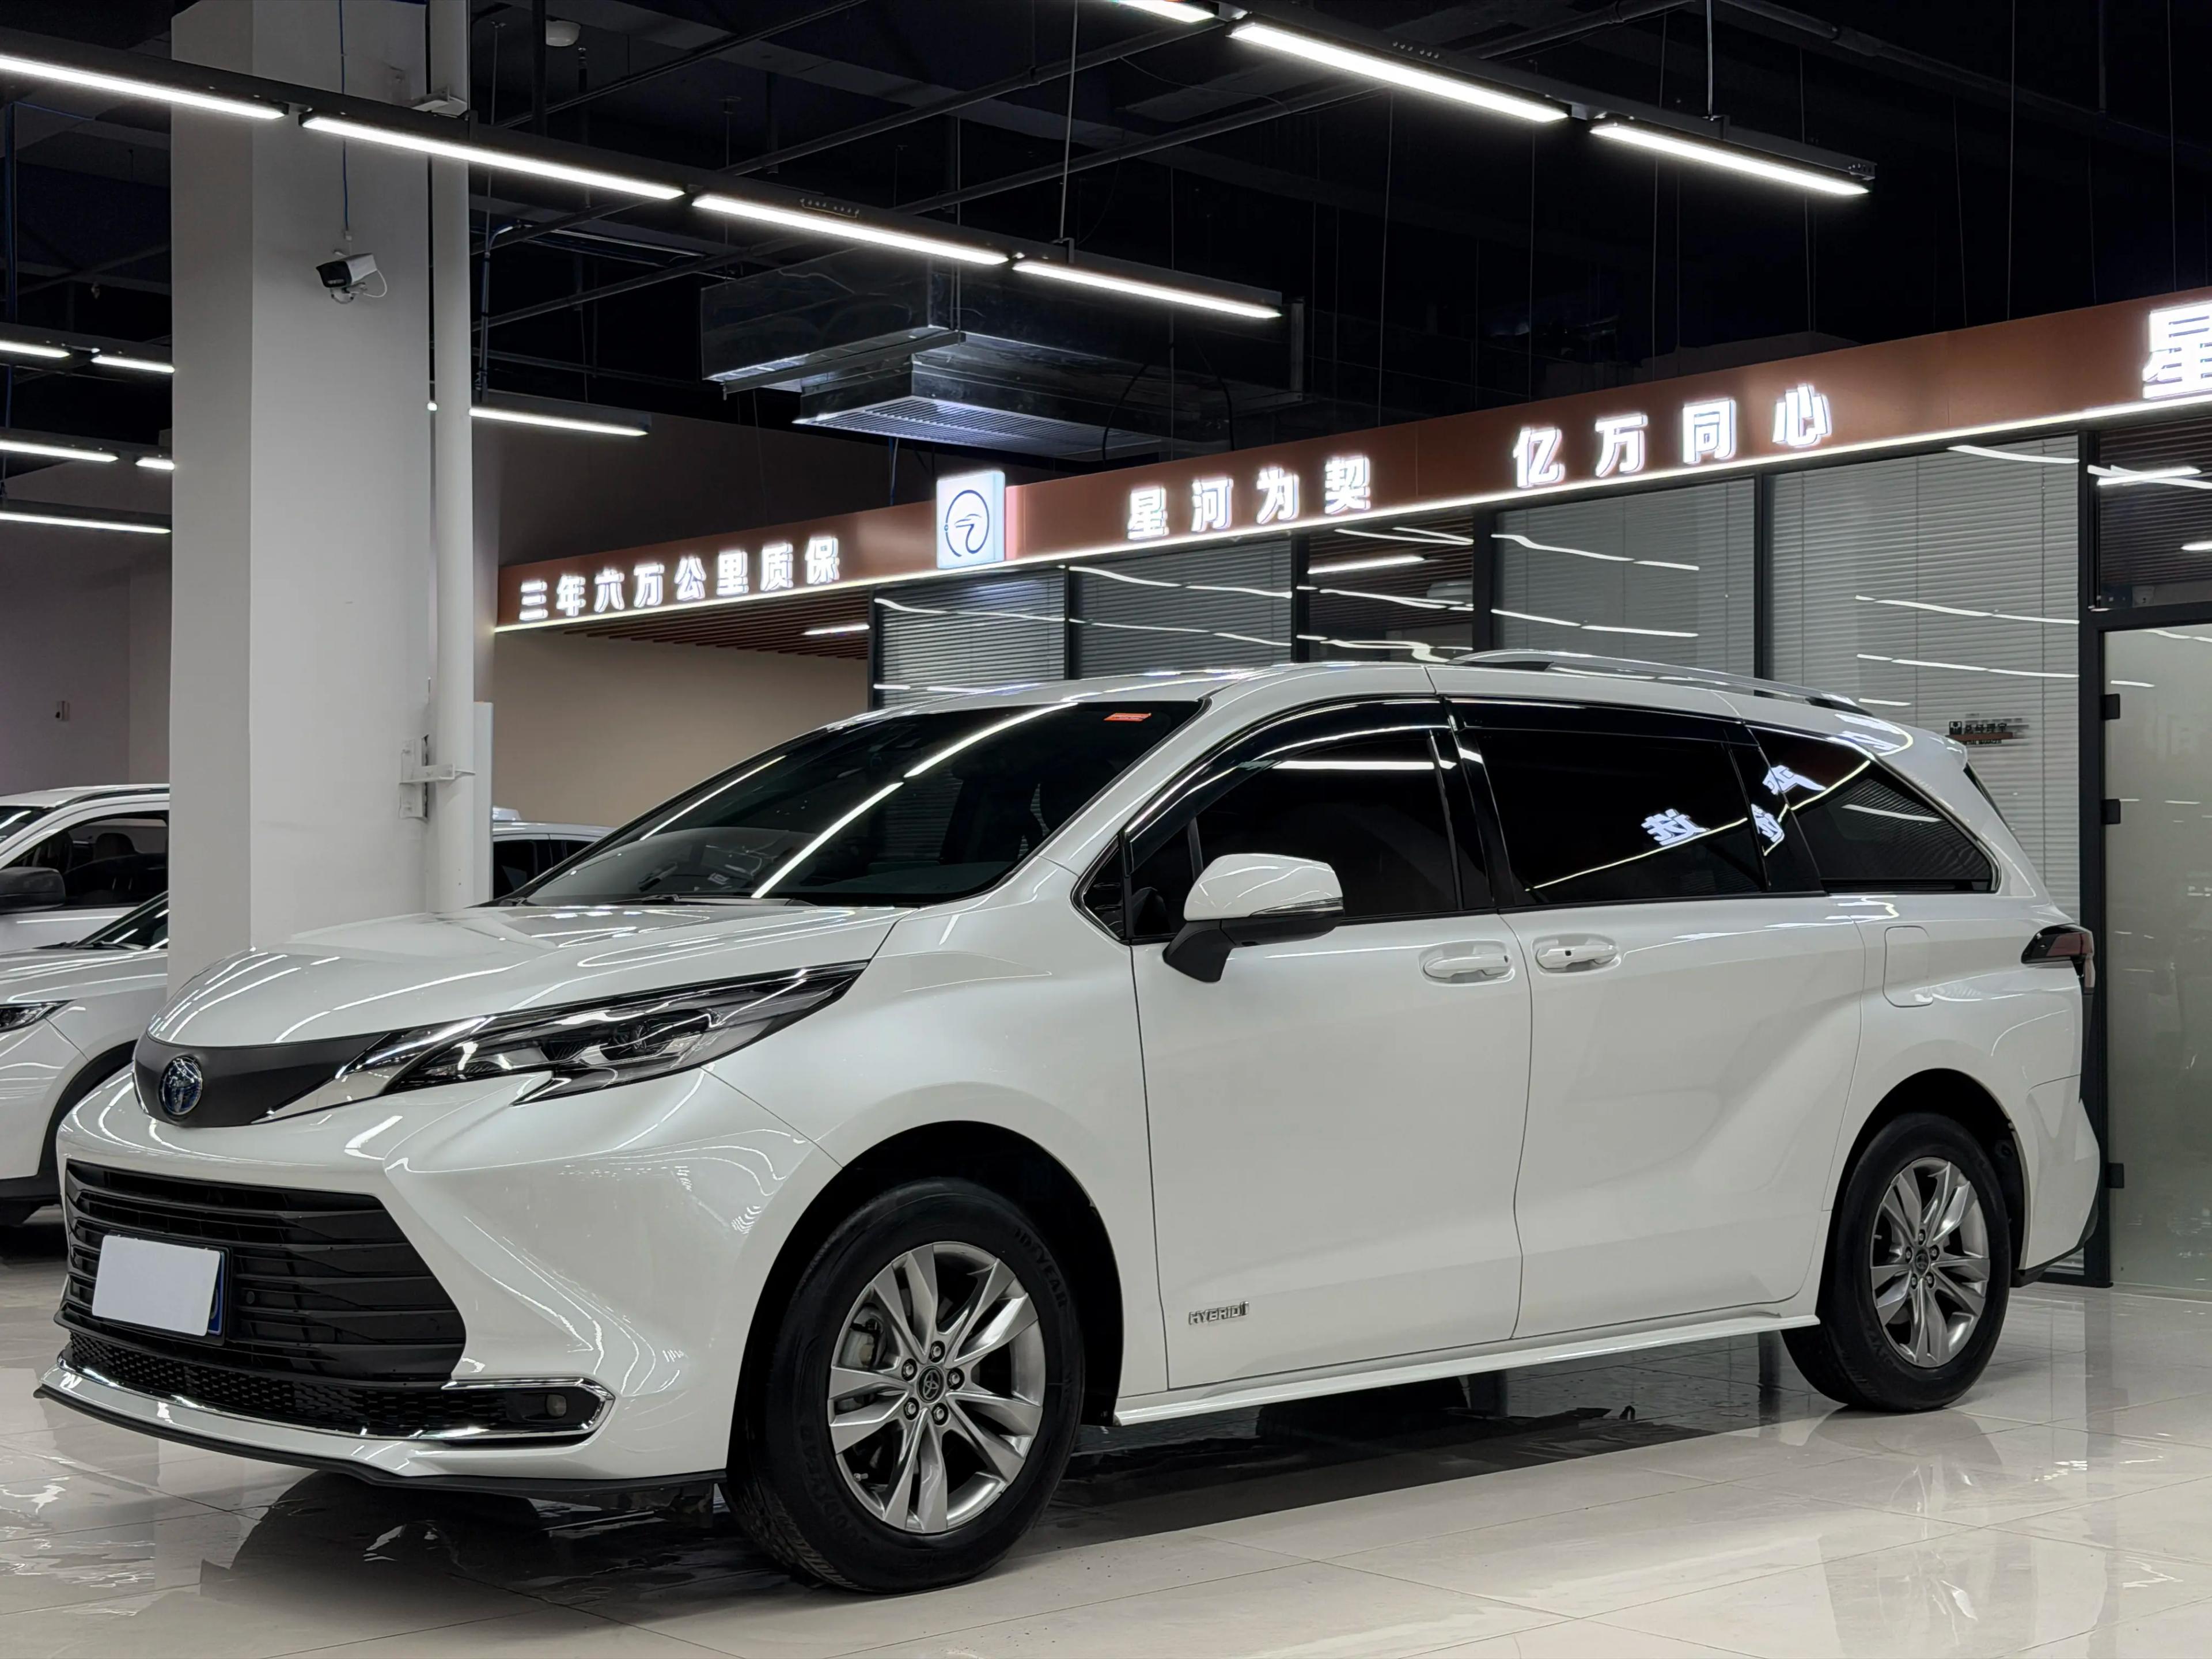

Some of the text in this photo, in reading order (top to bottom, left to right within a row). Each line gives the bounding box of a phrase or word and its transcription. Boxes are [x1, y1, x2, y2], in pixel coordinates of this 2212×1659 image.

[1127, 384, 1832, 540] 星河为契 亿万同心
[518, 536, 840, 621] 三年六万公里质保
[1188, 1304, 1242, 1325] HYBRID
